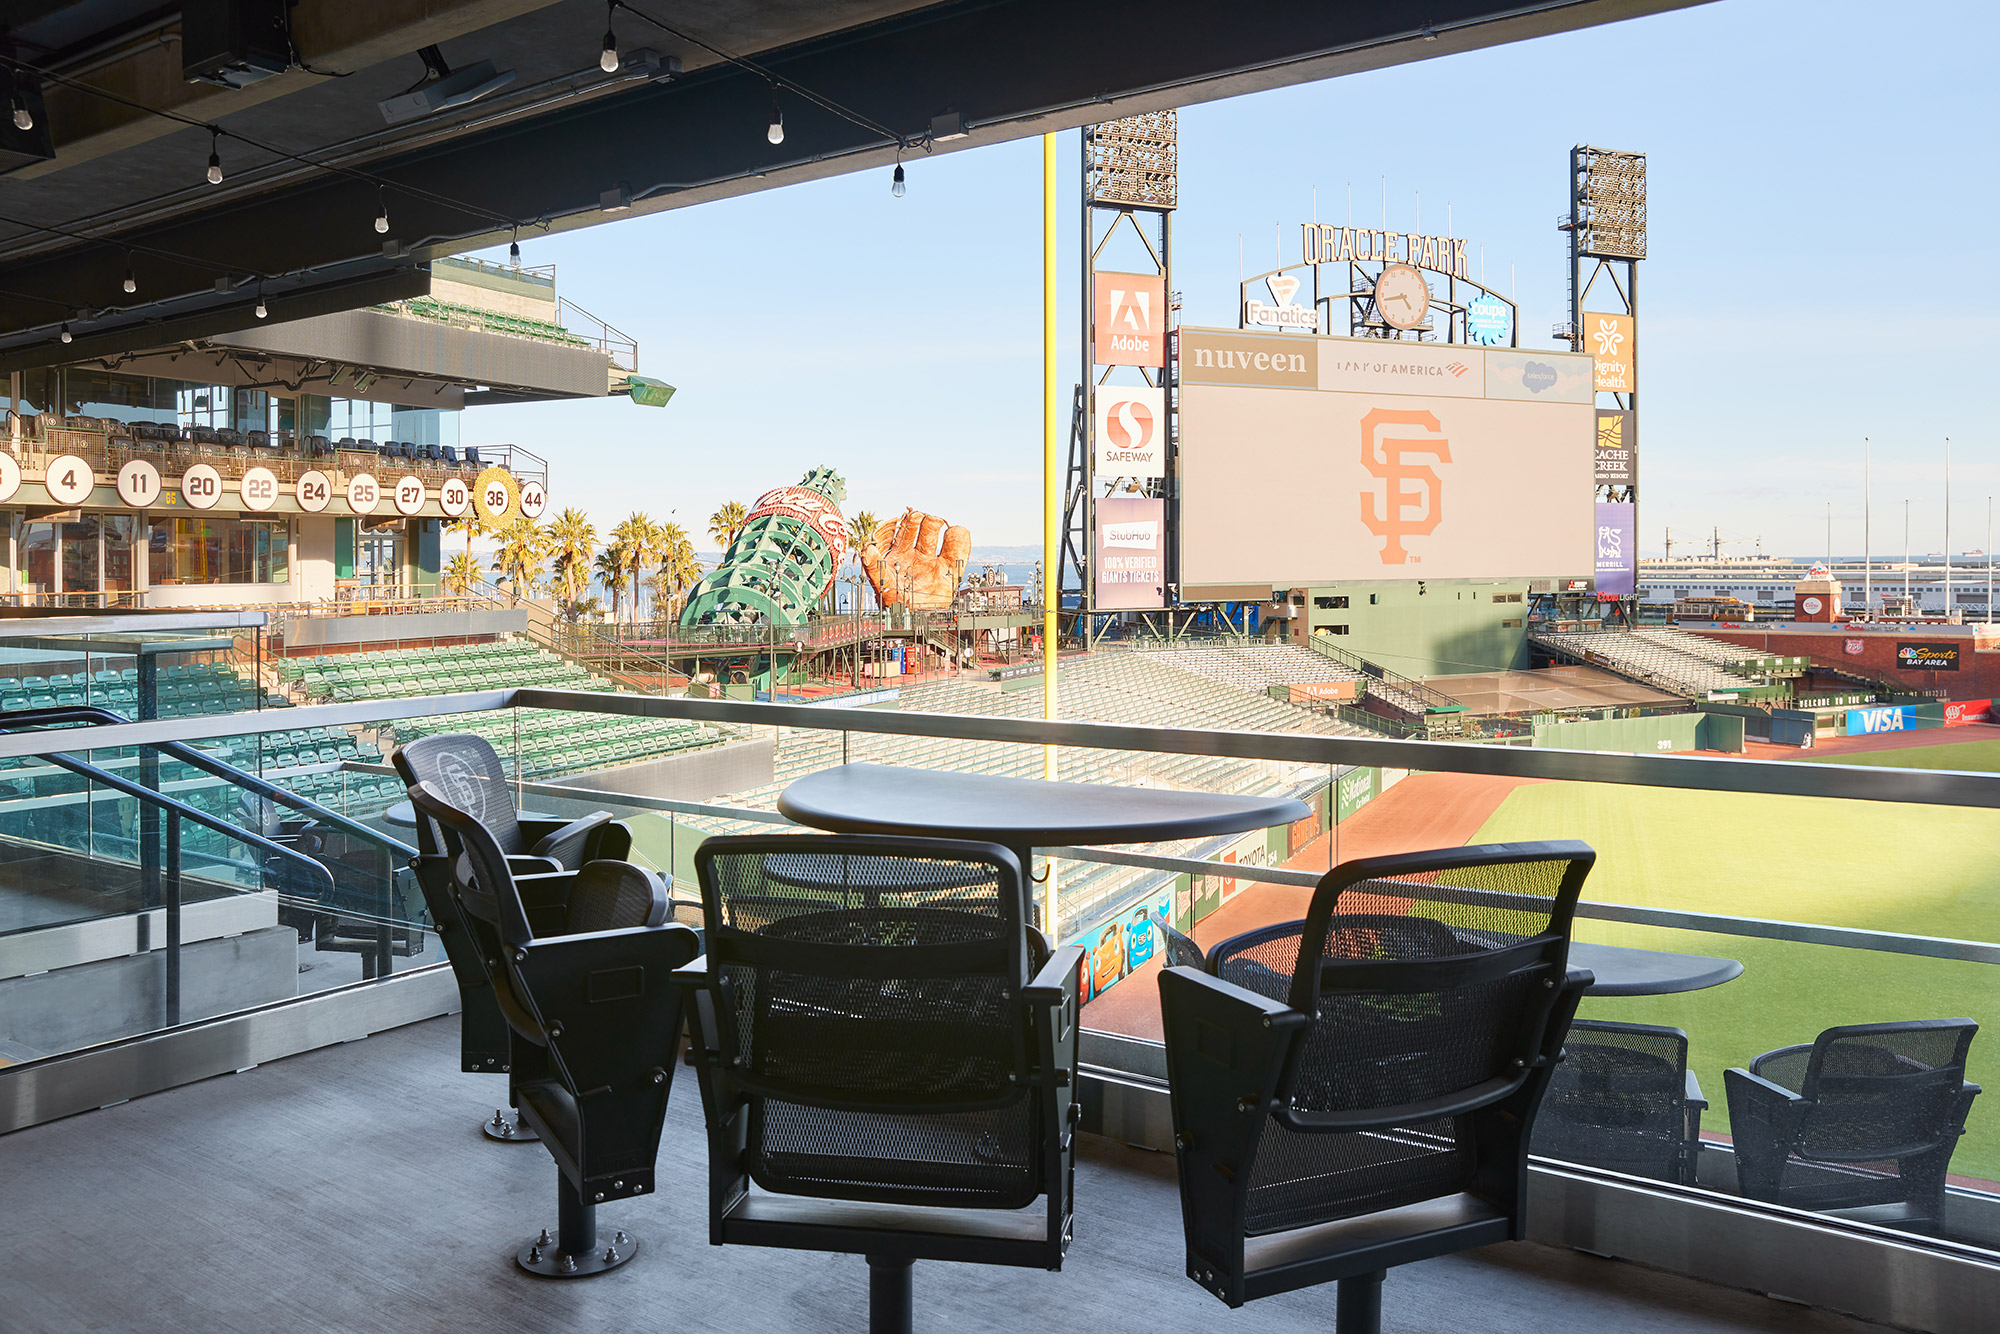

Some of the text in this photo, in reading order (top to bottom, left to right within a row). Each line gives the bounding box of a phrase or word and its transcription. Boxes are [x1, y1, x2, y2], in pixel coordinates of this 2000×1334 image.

[1303, 223, 1468, 281] ORACLE PARK
[1250, 303, 1318, 324] Fanatics
[1471, 303, 1506, 320] coupa
[1111, 334, 1149, 352] Adobe
[1194, 348, 1307, 373] nuveen
[1391, 364, 1443, 377] AMERICA
[1106, 451, 1154, 462] SAFEWAY
[61, 469, 77, 490] 4
[131, 473, 147, 493] 11
[190, 477, 214, 496] 20
[249, 479, 272, 498] 22
[303, 482, 326, 501] 24
[354, 484, 374, 502] 25
[401, 487, 419, 503] 27
[166, 492, 176, 504] 65
[446, 489, 464, 505] 30
[487, 490, 504, 507] 36
[524, 492, 542, 508] 44
[1104, 556, 1157, 569] 100% VERIFIED
[1102, 571, 1159, 583] GIANTS TICKETS
[1597, 590, 1638, 602] Coors LIGHT
[1916, 647, 1957, 661] Sports
[1319, 687, 1338, 695] Adobe
[1800, 697, 1829, 708] WELCOME
[1864, 694, 1876, 703] 415
[1859, 709, 1904, 733] VISA
[1657, 740, 1671, 749] 391
